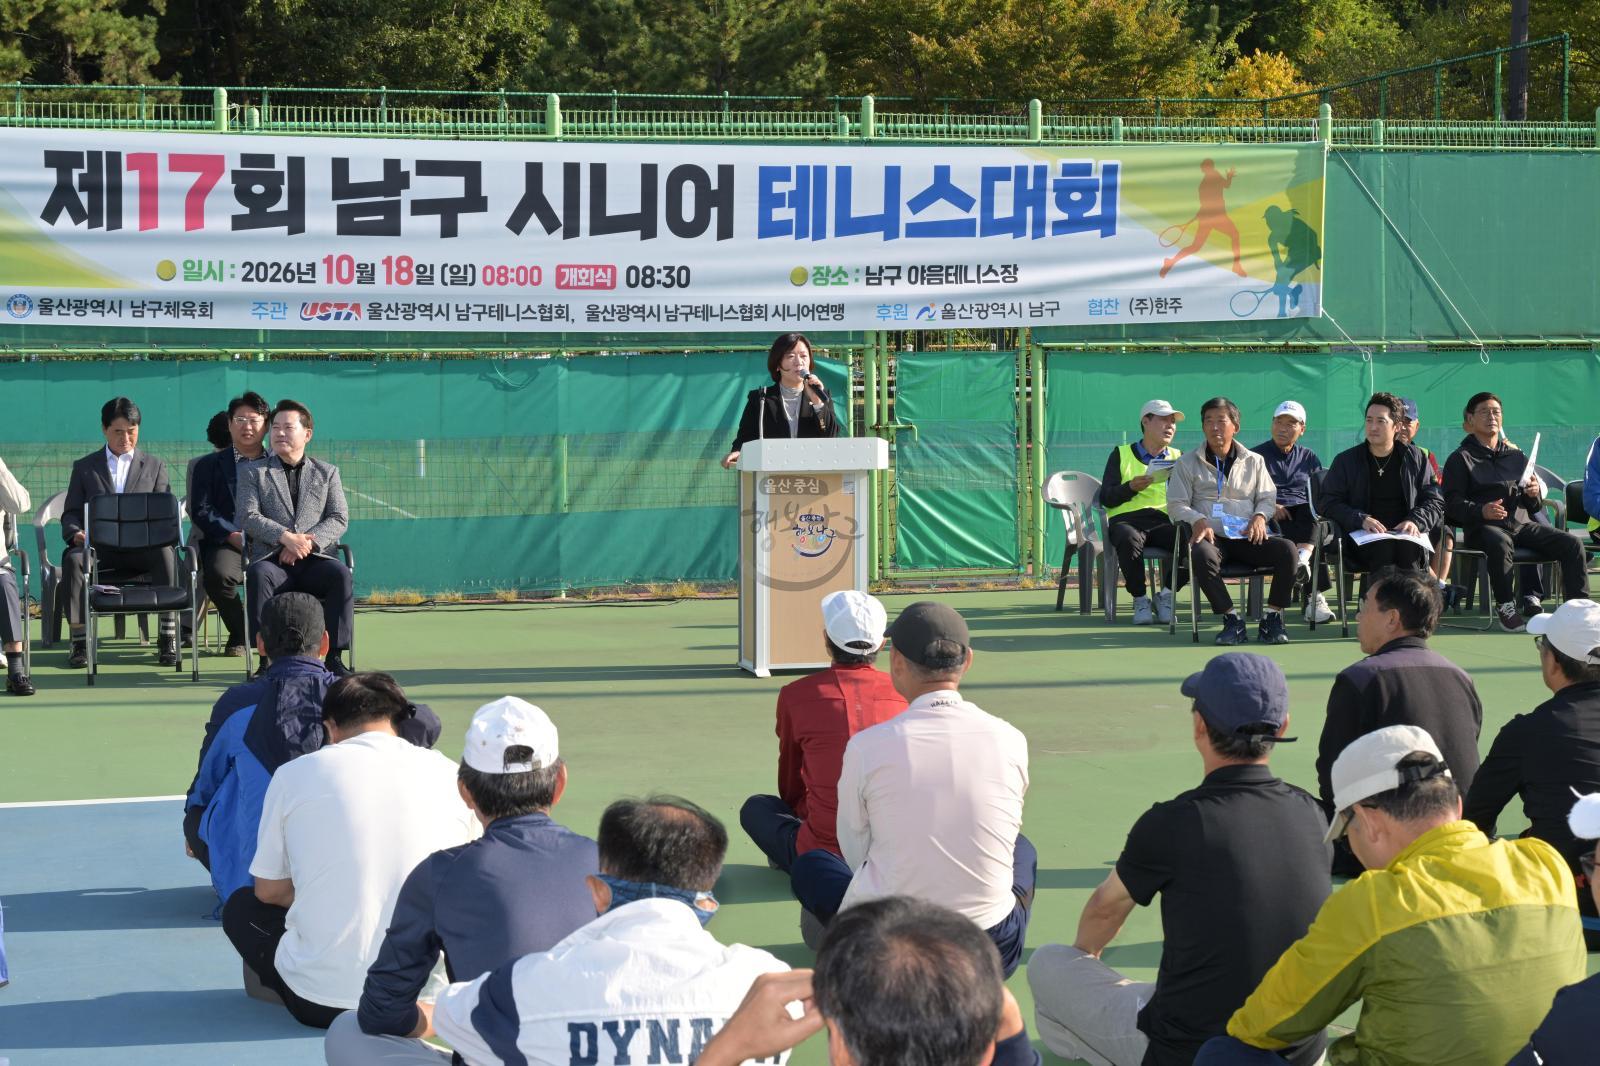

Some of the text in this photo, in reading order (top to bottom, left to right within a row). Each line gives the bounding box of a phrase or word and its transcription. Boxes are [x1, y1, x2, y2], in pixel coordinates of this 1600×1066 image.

[40, 149, 1120, 242] 제17회 남구 시니어 테니스대회
[241, 261, 317, 284] 2026년
[322, 254, 376, 285] 10월
[381, 255, 435, 286] 18일
[440, 262, 476, 287] (일)
[481, 264, 543, 287] 08:00
[560, 267, 612, 287] 개회식
[625, 264, 691, 288] 08:30
[865, 265, 902, 286] 남구
[907, 264, 1019, 285] 야음테니스장
[37, 297, 123, 318] 울산광역시
[129, 299, 214, 319] 남구체육회
[251, 302, 288, 321] 주관
[299, 301, 362, 322] USTA
[366, 301, 450, 322] 울산광역시
[585, 303, 661, 323] 울산광역시
[664, 303, 768, 323] 남구테니스협회
[771, 303, 845, 322] 시니어연맹
[876, 300, 1061, 322] 후원 울산광역시 남구
[1087, 296, 1183, 317] 협찬 (주)한주
[567, 1017, 728, 1066] DYNA
